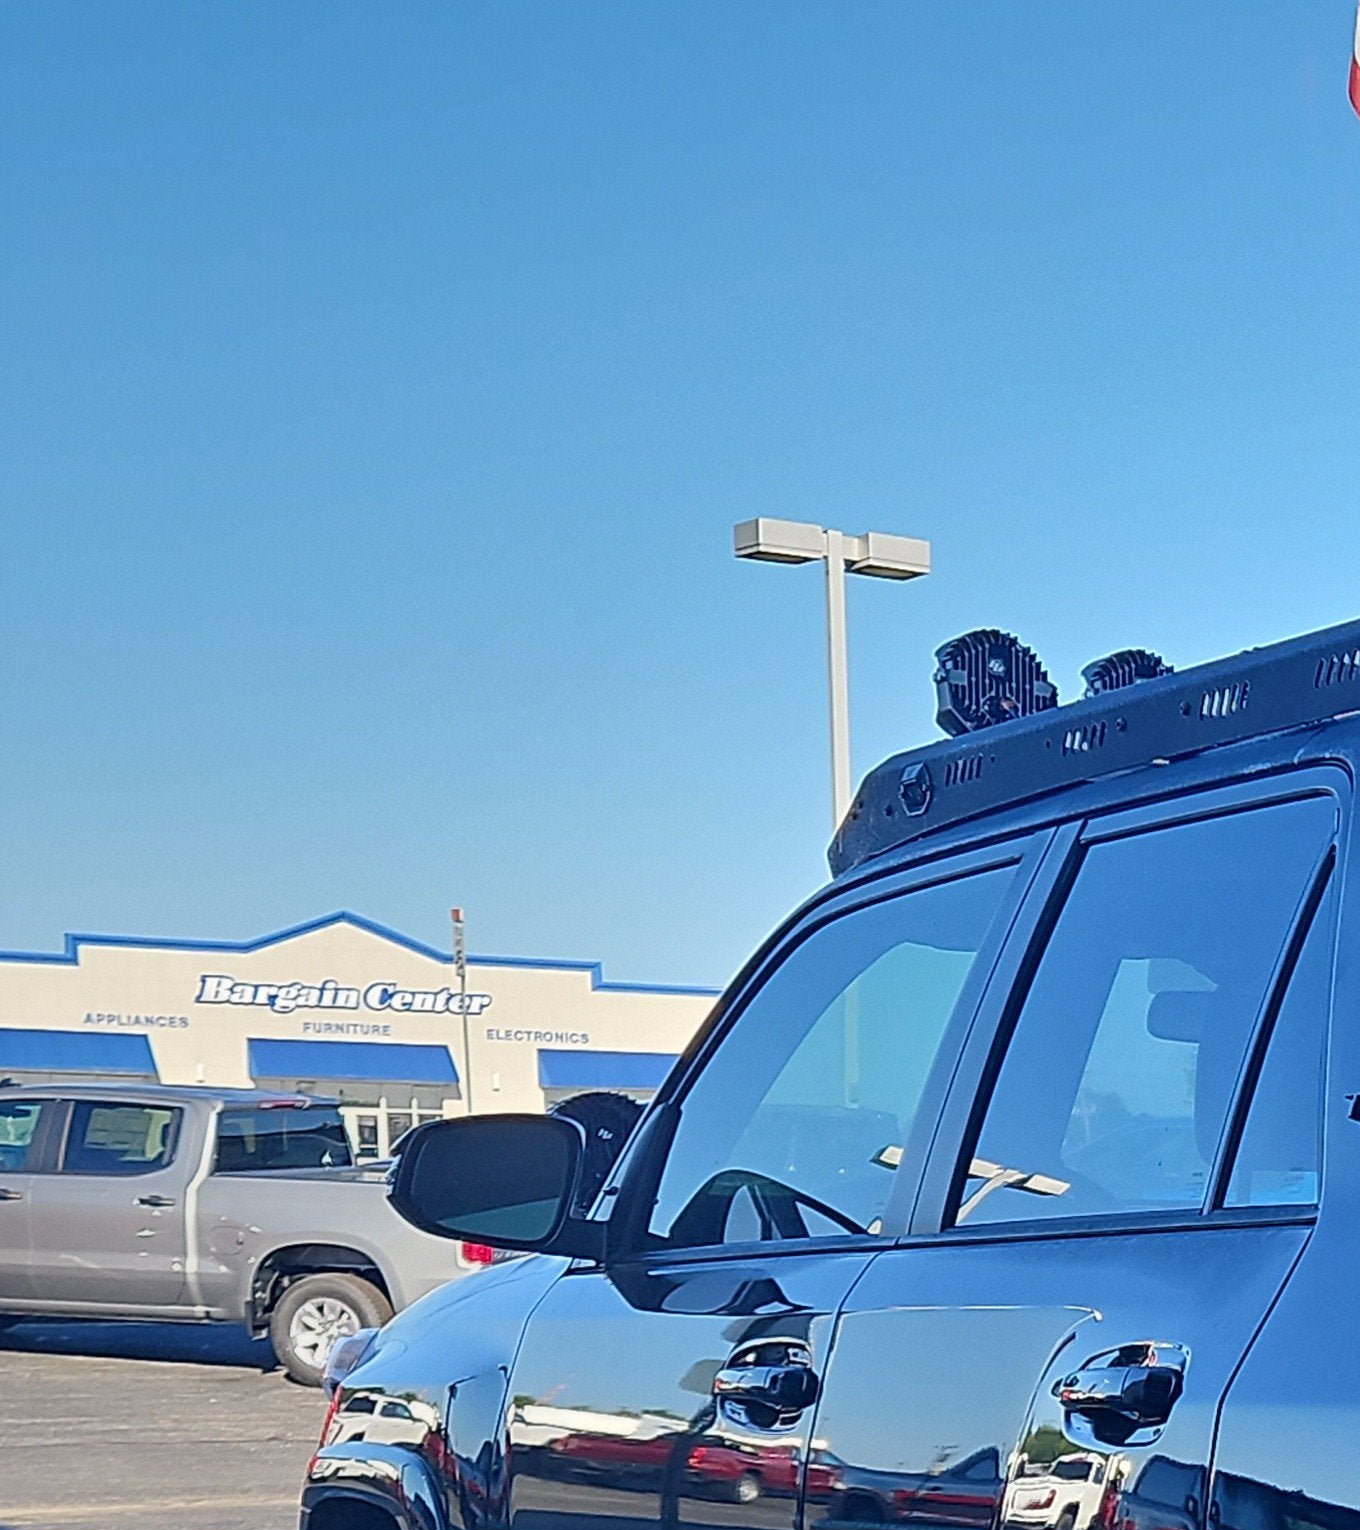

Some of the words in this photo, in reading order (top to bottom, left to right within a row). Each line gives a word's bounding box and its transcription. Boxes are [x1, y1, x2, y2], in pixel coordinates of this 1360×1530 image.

[195, 974, 360, 1013] Bargain
[365, 982, 492, 1015] Center
[83, 1012, 190, 1029] APPLIANCES
[302, 1021, 392, 1037] FURNITURE
[486, 1028, 590, 1044] ELECTRONICS
